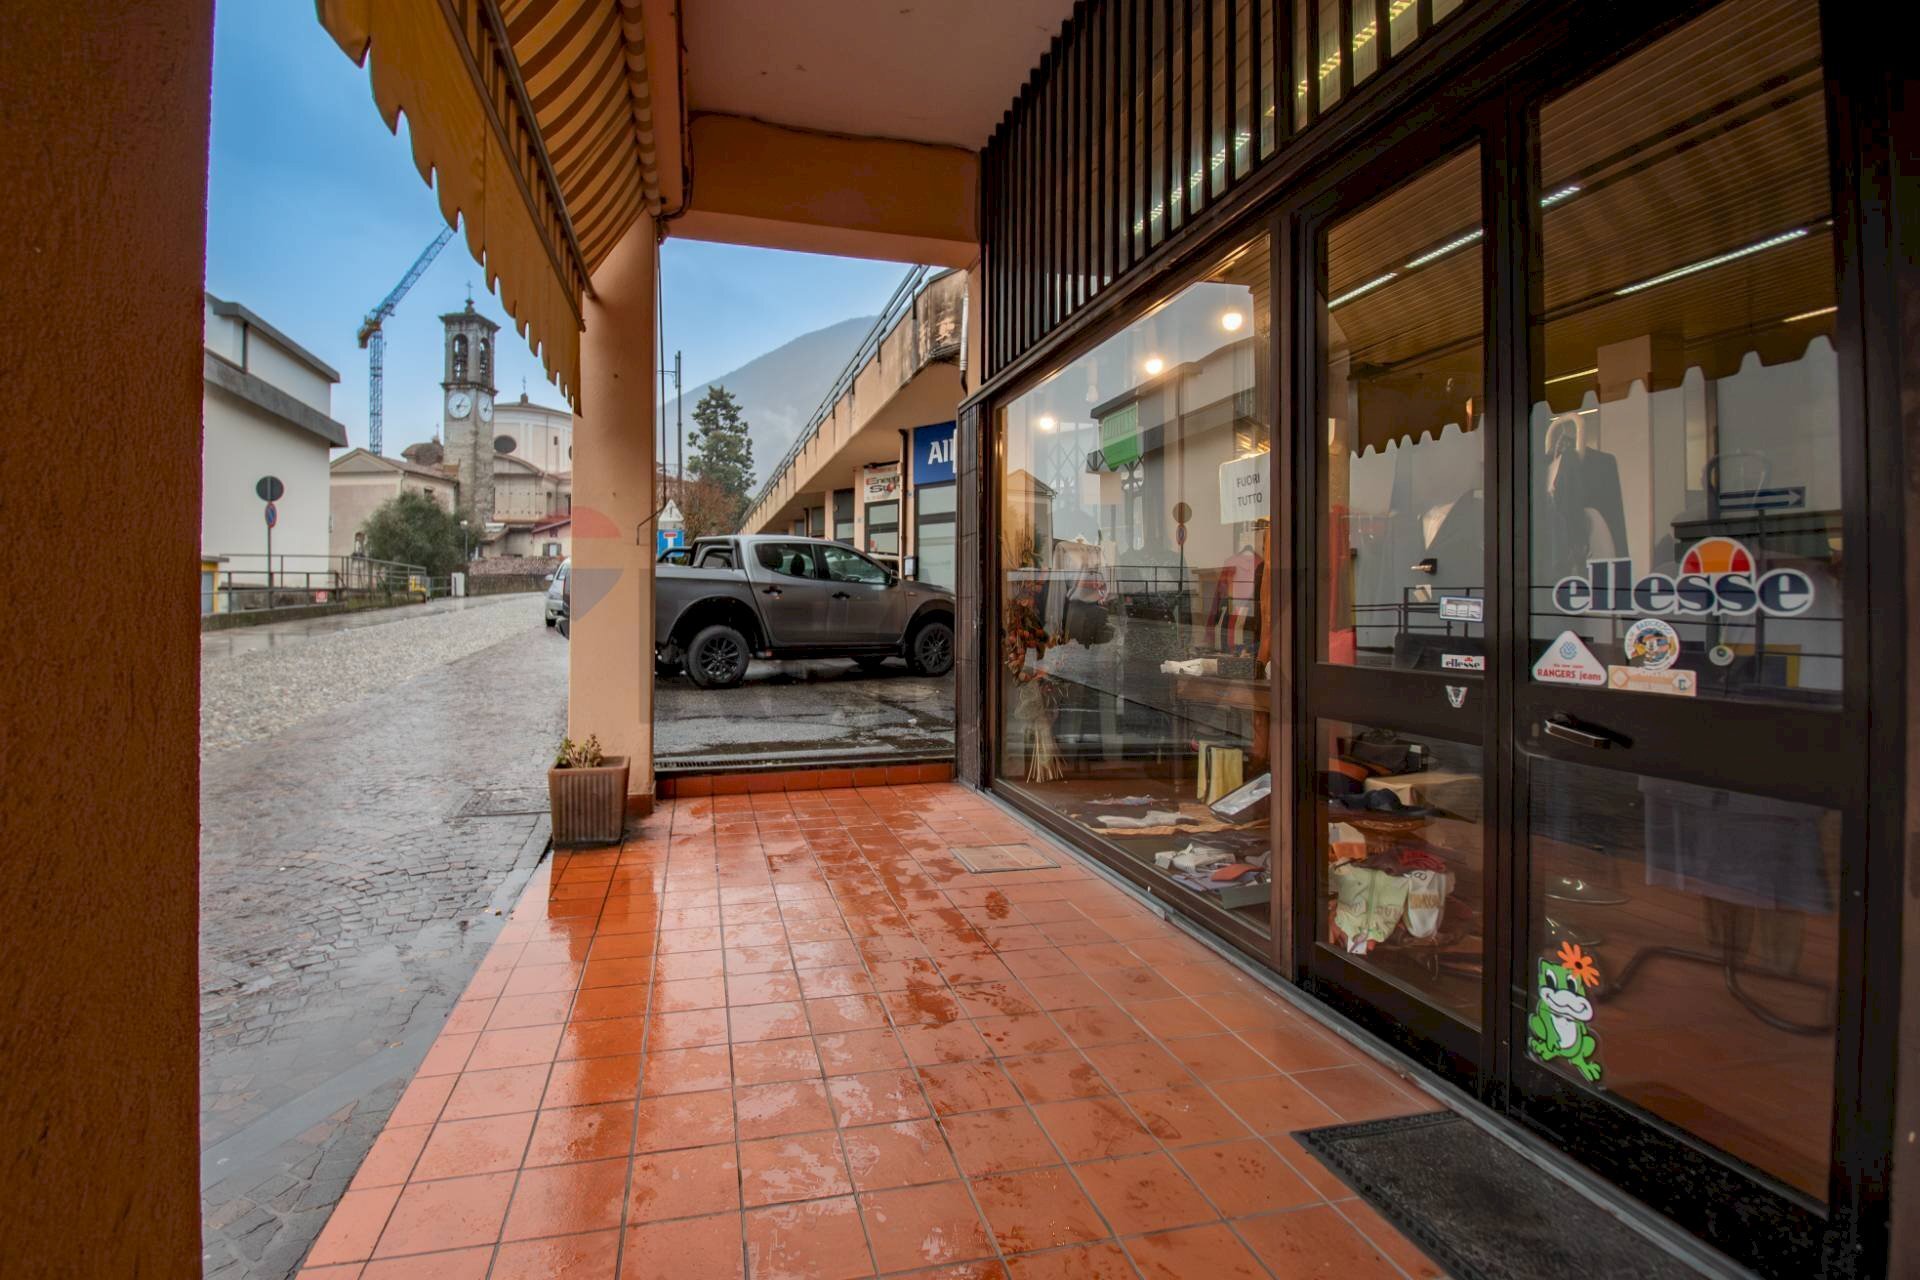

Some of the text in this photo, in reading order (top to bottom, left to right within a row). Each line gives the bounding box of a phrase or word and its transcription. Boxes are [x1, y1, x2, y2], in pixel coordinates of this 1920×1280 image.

[1236, 472, 1260, 488] FUORI
[1237, 493, 1262, 507] TUTTO
[1553, 557, 1814, 616] ellesse
[1445, 659, 1480, 668] ellesse
[1537, 668, 1602, 681] RANGERS jeans
